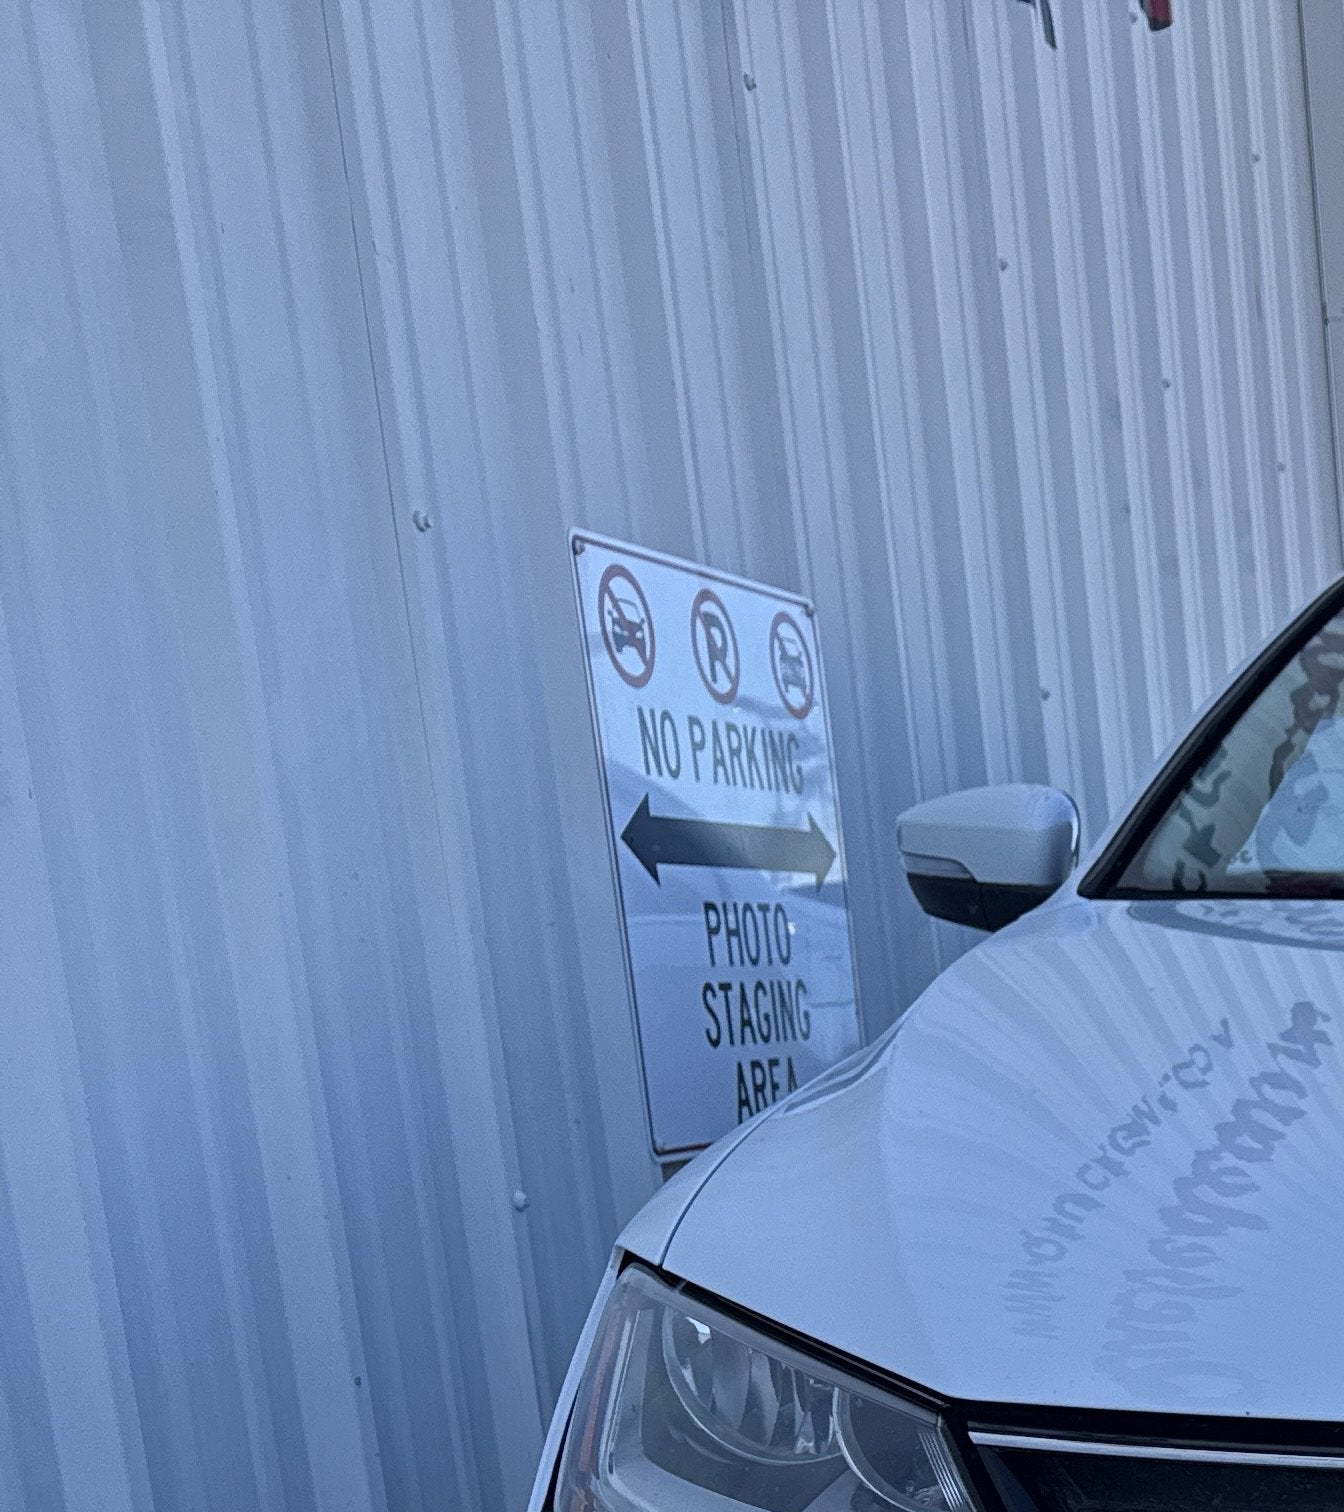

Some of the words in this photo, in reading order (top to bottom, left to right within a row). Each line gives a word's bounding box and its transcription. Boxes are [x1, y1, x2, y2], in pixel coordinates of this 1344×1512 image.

[637, 704, 682, 787] NO
[686, 714, 804, 796] PARKING
[703, 901, 792, 968] PHOTO
[702, 979, 811, 1049] STAGING
